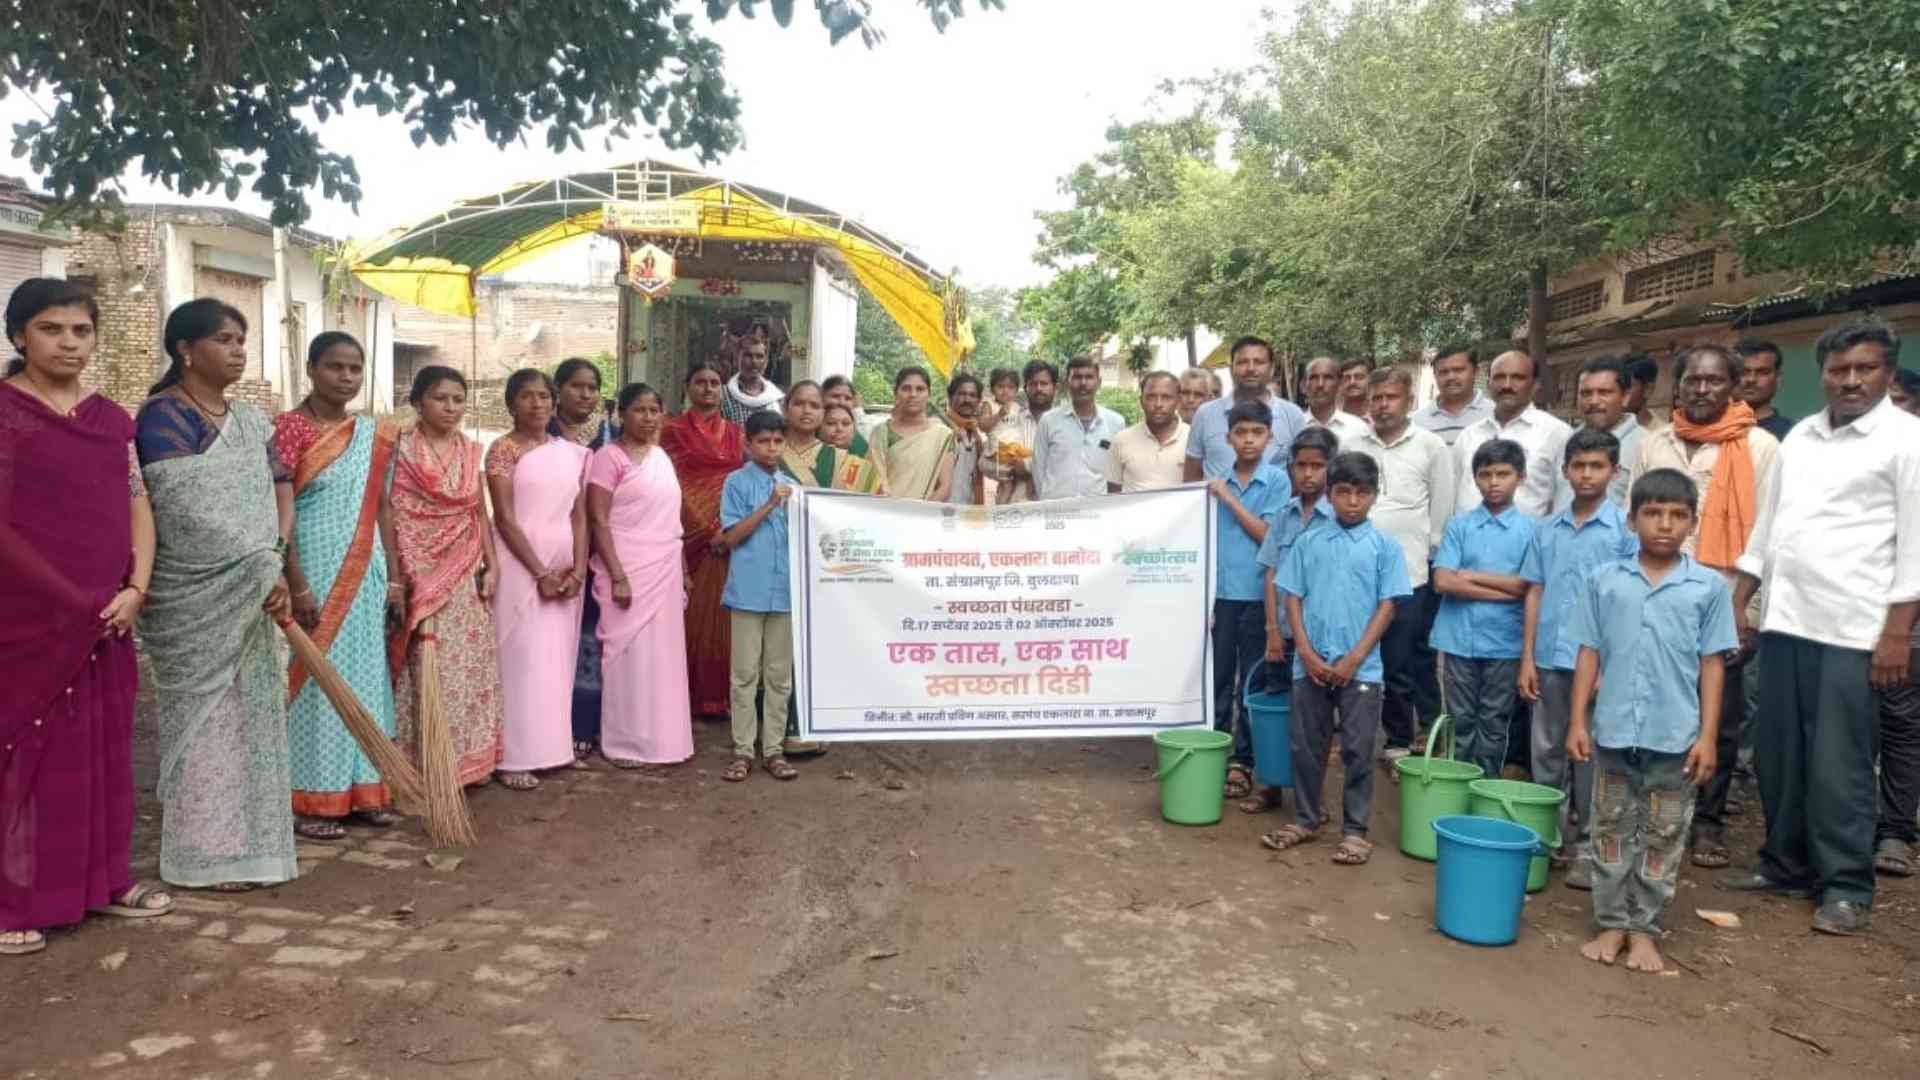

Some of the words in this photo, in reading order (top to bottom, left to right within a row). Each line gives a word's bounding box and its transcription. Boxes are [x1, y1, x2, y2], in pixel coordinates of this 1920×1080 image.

[901, 548, 986, 569] ग्रामपंचायत,
[988, 551, 1049, 567] एकलारा
[924, 575, 942, 588] ता.
[946, 572, 1000, 591] संग्रामपूर
[1003, 571, 1024, 587] जि.
[946, 599, 1008, 615] स्वच्छता
[1011, 596, 1072, 614] पंधरवडा
[972, 619, 1001, 631] 2025
[1003, 616, 1014, 631] ते
[1016, 619, 1032, 630] 02
[1084, 616, 1115, 628] 2025
[886, 639, 938, 665] एक
[942, 640, 1008, 667] तास,
[1014, 639, 1065, 663] एक
[1069, 637, 1130, 662] साथ
[925, 672, 1031, 697] स्वच्छता
[1036, 664, 1093, 696] दिंडी
